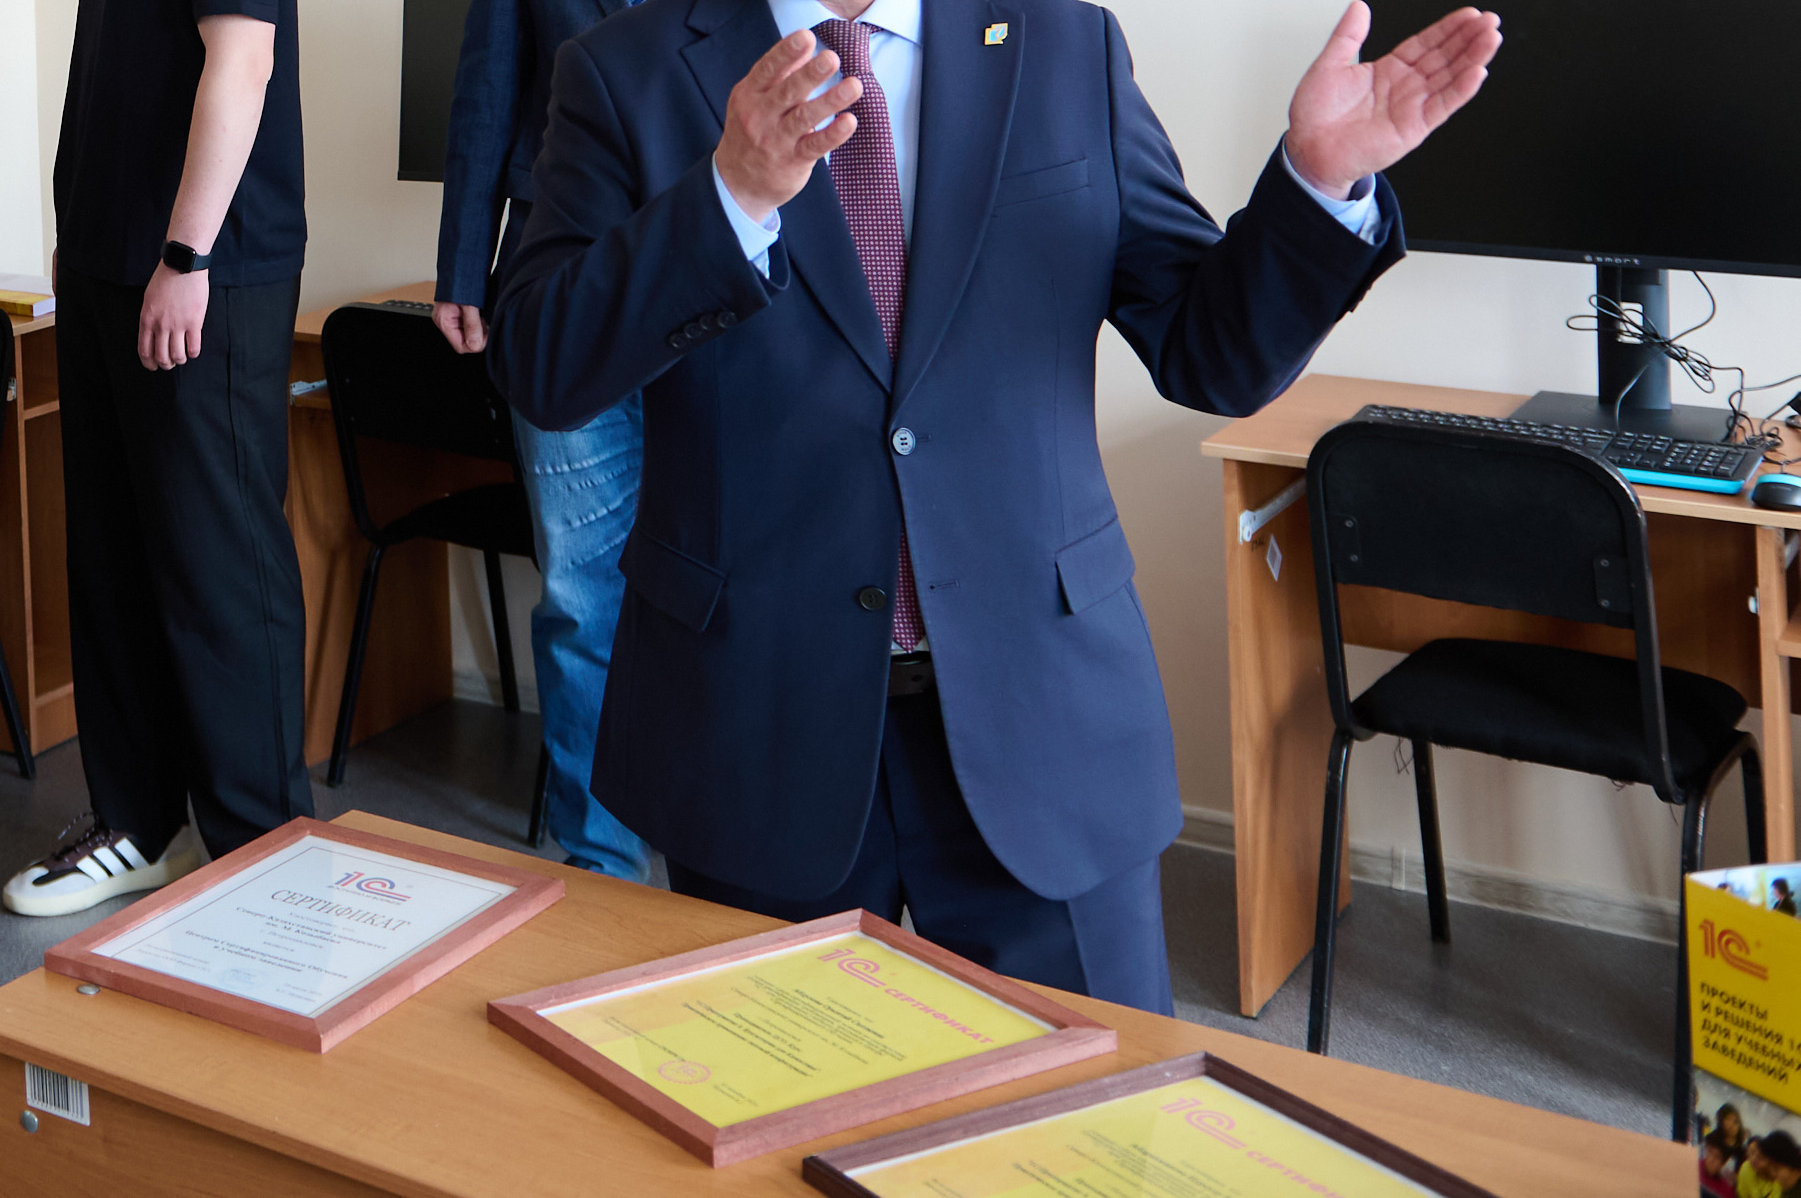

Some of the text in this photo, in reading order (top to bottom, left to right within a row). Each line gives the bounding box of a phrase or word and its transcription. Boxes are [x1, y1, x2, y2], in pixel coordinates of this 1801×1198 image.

[271, 889, 412, 931] СЕРТИФИКАТ
[884, 988, 995, 1044] СЕРТИФИКАТ
[1701, 983, 1767, 1020] ПРОЕКТЫ
[1702, 1019, 1730, 1039] ДЛЯ
[1716, 1007, 1782, 1045] РЕШЕНИЯ
[1703, 1036, 1788, 1084] ЗАВЕДЕНИЙ
